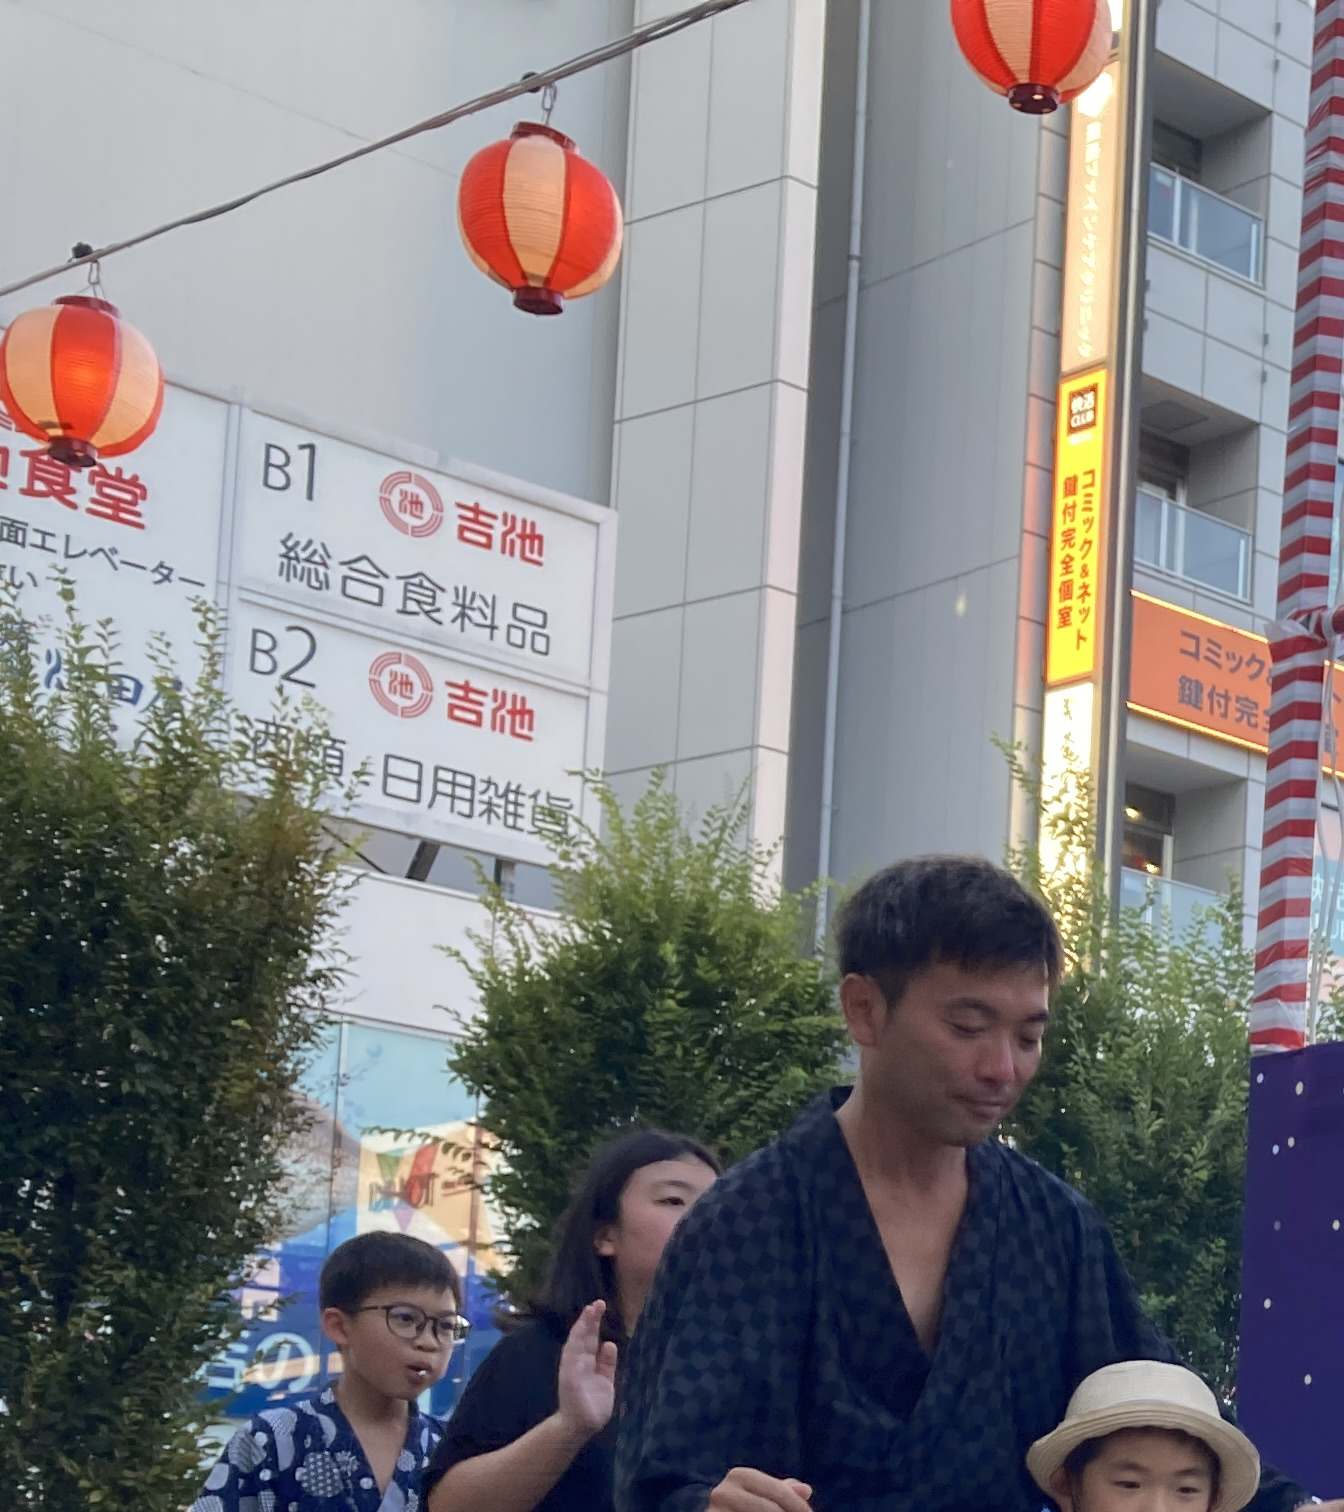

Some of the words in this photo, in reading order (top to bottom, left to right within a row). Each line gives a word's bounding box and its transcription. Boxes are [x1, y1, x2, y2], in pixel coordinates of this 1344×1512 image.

[262, 442, 316, 501] B1
[455, 501, 545, 567] 吉池
[278, 531, 551, 657] 総合食料品
[249, 625, 318, 689] B2
[445, 679, 535, 742] 吉池
